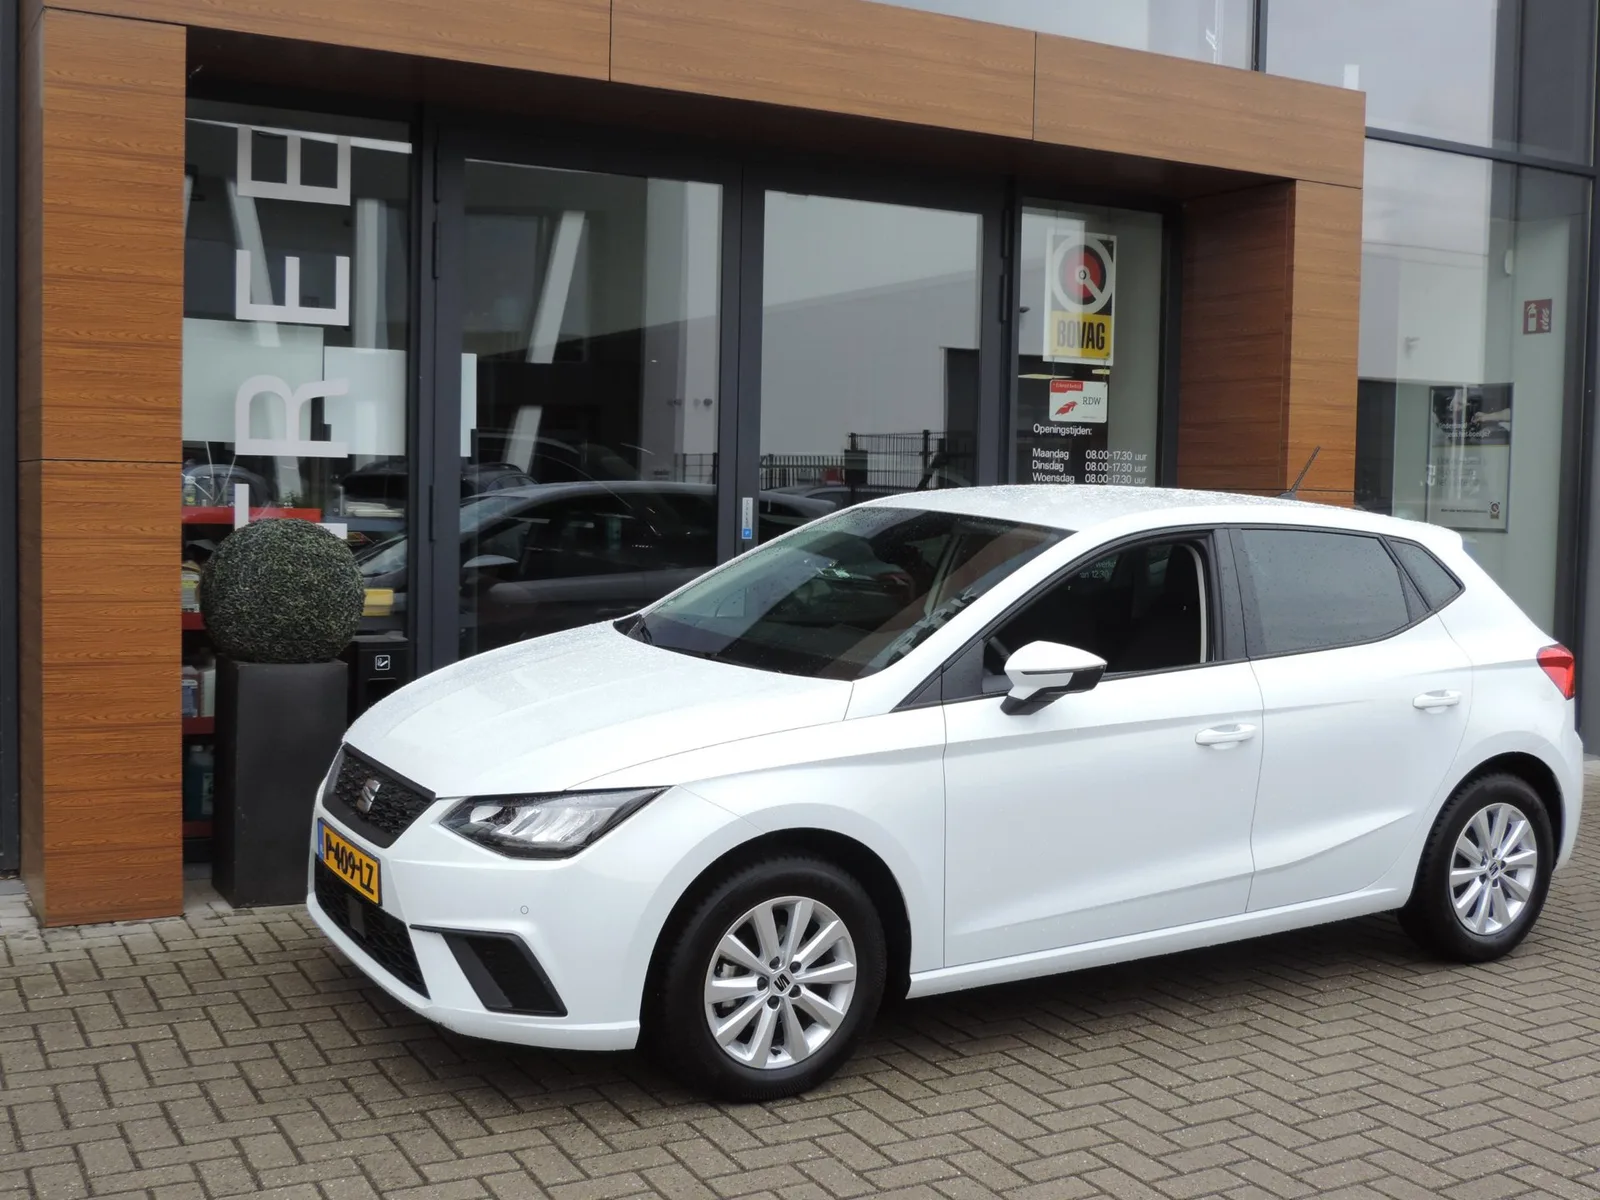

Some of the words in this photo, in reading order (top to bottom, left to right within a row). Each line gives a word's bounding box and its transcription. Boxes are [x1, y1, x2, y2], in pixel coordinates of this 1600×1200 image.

[1057, 319, 1105, 350] BOVAG
[1082, 396, 1101, 405] RDW
[1033, 423, 1092, 436] Openingstijden:
[1032, 448, 1069, 460] Maandag
[1085, 450, 1132, 460] 08.00-17.30
[1134, 453, 1147, 461] uur
[1032, 460, 1064, 472] Dinsdag
[1085, 462, 1132, 472] 08.00-17.30
[1134, 465, 1147, 473] uur
[1032, 472, 1075, 484] Woensdag
[1085, 474, 1132, 484] 08.00-17.30
[1134, 477, 1147, 485] uur
[325, 832, 375, 895] P-409-LZ
